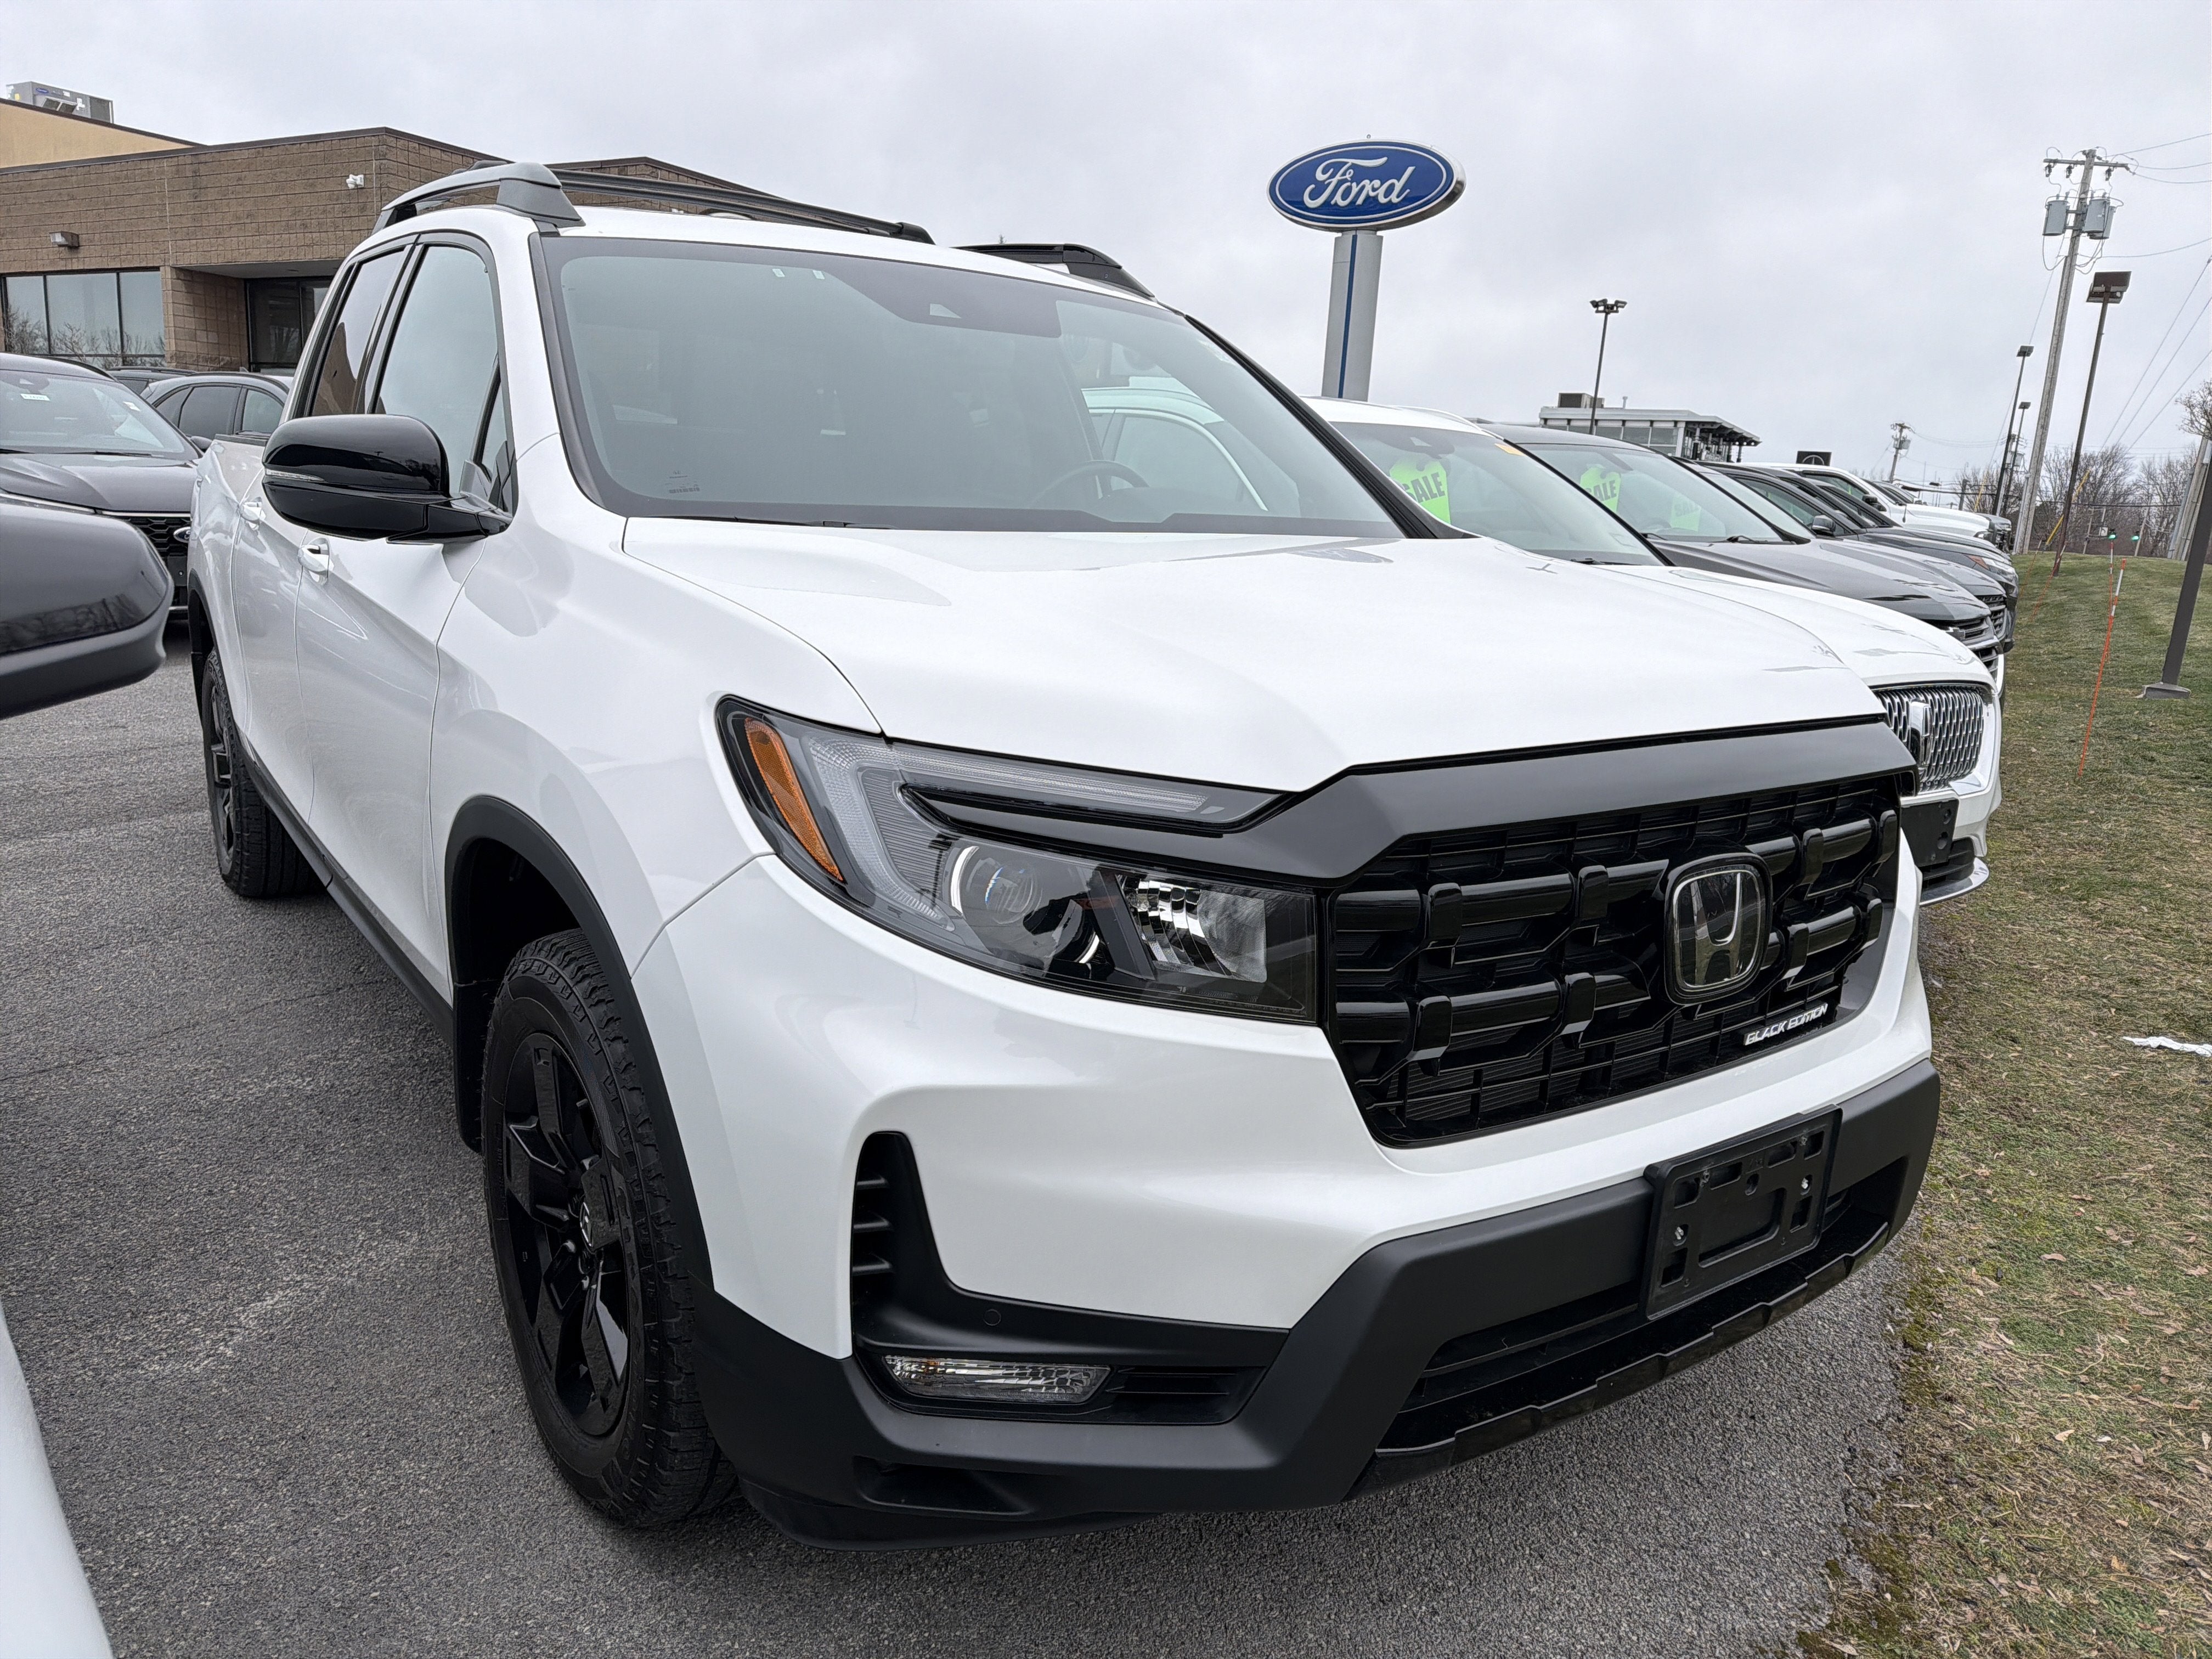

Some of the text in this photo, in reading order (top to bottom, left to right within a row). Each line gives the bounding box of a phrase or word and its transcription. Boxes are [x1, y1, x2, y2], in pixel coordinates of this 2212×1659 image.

[1304, 156, 1416, 208] Ford
[1585, 479, 1617, 501] ALE
[1743, 1003, 1829, 1046] BLACK EDITION
